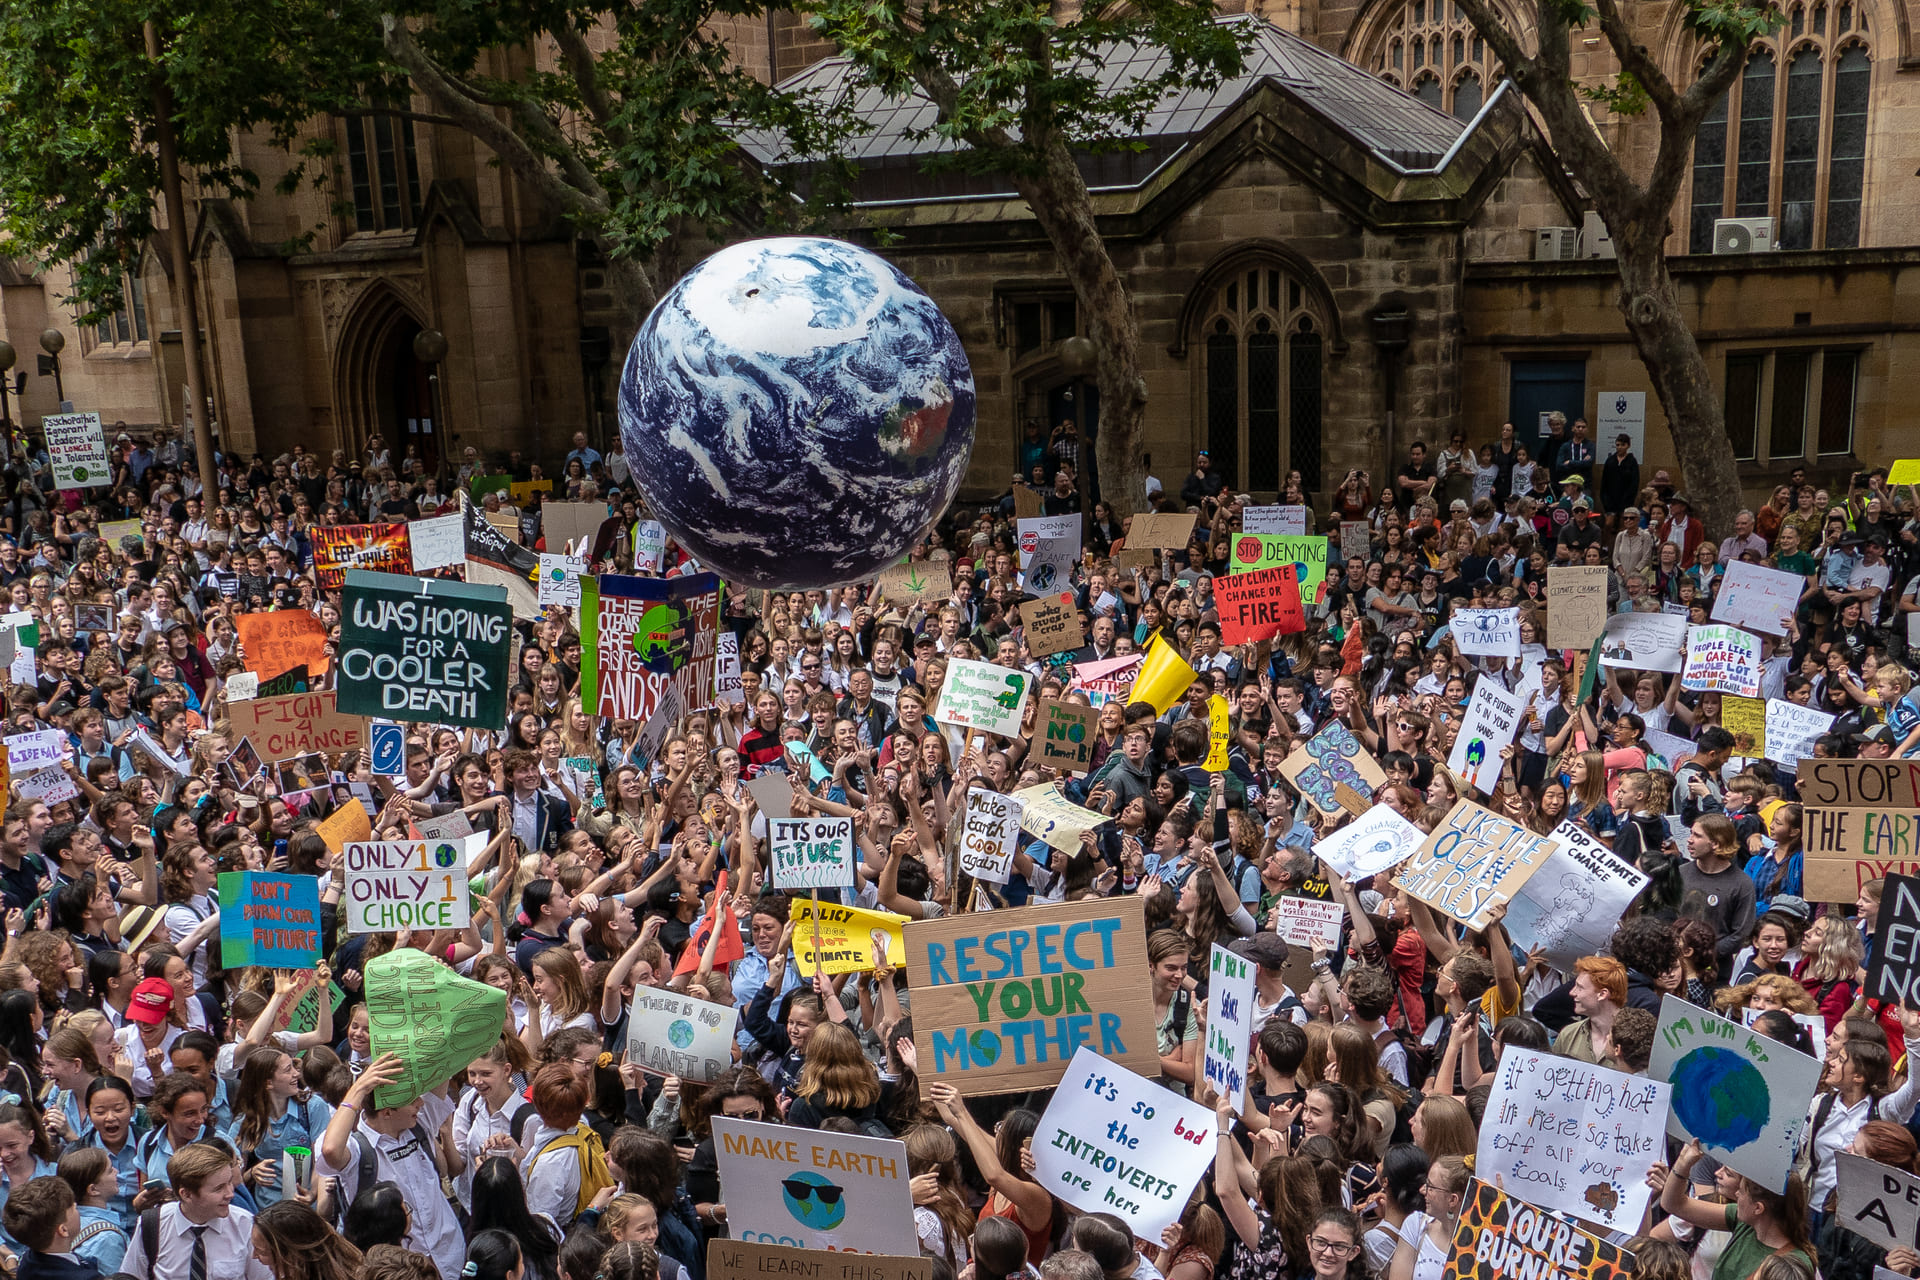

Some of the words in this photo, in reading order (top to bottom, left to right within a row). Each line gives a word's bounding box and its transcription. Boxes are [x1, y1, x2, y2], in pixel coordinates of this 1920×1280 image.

[46, 424, 88, 437] Ignorant
[48, 435, 84, 446] Leaders
[64, 444, 93, 452] LONGER
[65, 449, 105, 462] Tolerated
[1040, 521, 1073, 530] DENYING
[357, 550, 390, 563] WHILE
[1035, 552, 1072, 562] PLANET
[1038, 540, 1054, 551] NO
[1238, 543, 1262, 554] STOP
[1266, 542, 1326, 562] DENYING
[541, 558, 552, 567] IS
[566, 556, 581, 566] B
[414, 578, 435, 600] I
[541, 575, 551, 601] THERE
[565, 568, 580, 606] PLANET
[1218, 574, 1244, 590] STOP
[1247, 567, 1290, 585] CLIMATE
[686, 592, 717, 611] THE
[1226, 588, 1266, 602] CHANGE
[1269, 586, 1282, 597] OR
[600, 597, 644, 616] THE
[1239, 602, 1281, 626] FIRE
[353, 598, 418, 632] WAS
[421, 605, 507, 643] HOPING
[598, 612, 640, 633] OCEANS
[1032, 614, 1061, 632] gives
[1041, 622, 1065, 635] crap
[402, 637, 446, 658] FOR
[452, 641, 470, 660] A
[598, 632, 633, 650] ARE
[1694, 641, 1724, 652] PEOPLE
[1728, 643, 1753, 658] LIKE
[1697, 626, 1752, 650] UNLESS
[342, 648, 491, 690] COOLER
[600, 650, 644, 671] RISING
[718, 657, 736, 674] IF
[1690, 662, 1723, 671] WHOLE
[1727, 662, 1751, 676] LOT
[1706, 651, 1734, 662] CARE
[1737, 656, 1746, 665] A
[955, 665, 975, 677] I'm
[1729, 674, 1756, 686] WILL
[259, 673, 294, 697] ZERO
[599, 672, 645, 720] AND
[253, 693, 336, 724] FIGHT
[383, 683, 477, 718] DEATH
[1480, 687, 1492, 704] OUR
[1492, 697, 1516, 718] FUTURE
[1050, 705, 1077, 723] There
[1475, 703, 1481, 713] IS
[1482, 708, 1491, 720] IN
[1493, 714, 1510, 733] YOUR
[17, 733, 42, 743] VOTE
[296, 720, 312, 734] 4
[1476, 722, 1495, 740] HANDS
[268, 728, 358, 754] CHANGE
[1044, 742, 1075, 760] Planet
[9, 745, 61, 763] LIBERAL
[1814, 763, 1900, 804] STOP
[969, 794, 1006, 817] Make
[426, 829, 440, 839] KEEP
[776, 822, 809, 841] IT'S
[814, 820, 849, 839] OUR
[967, 816, 1007, 839] Earth
[1449, 804, 1509, 844] LIKE
[1499, 825, 1550, 865] THE
[1804, 809, 1849, 852] THE
[349, 844, 414, 871] ONLY
[414, 843, 432, 871] 1
[966, 834, 1006, 857] COOL
[1556, 822, 1591, 848] STOP
[1590, 848, 1642, 888] CLIMATE
[963, 853, 1010, 875] again!
[1411, 851, 1445, 880] WE
[1433, 831, 1517, 887] OCEAN
[1567, 848, 1612, 883] CHANGE
[252, 881, 292, 900] DON'T
[352, 876, 429, 901] ONLY
[440, 875, 457, 901] 1
[1429, 870, 1508, 929] RISE
[243, 904, 281, 921] BURN
[284, 908, 314, 924] OUR
[364, 901, 452, 928] CHOICE
[801, 908, 855, 923] POLICY
[1288, 908, 1308, 916] GREEN
[1311, 910, 1327, 919] AGAIN
[1295, 919, 1316, 928] GREED
[253, 929, 318, 951] FUTURE
[927, 918, 1121, 985] RESPECT
[1212, 951, 1223, 972] WHY
[407, 955, 438, 998] THAN
[368, 955, 407, 1029] CHANGE
[966, 972, 1092, 1022] YOUR
[640, 996, 679, 1013] THERE
[682, 1003, 693, 1016] IS
[698, 1008, 721, 1027] NO
[411, 1001, 447, 1069] WORSE
[932, 1013, 1127, 1073] MOTHER
[630, 1039, 698, 1078] PLANET
[705, 1059, 721, 1081] B
[1537, 1066, 1614, 1115] getting
[1619, 1081, 1656, 1114] hot
[1085, 1073, 1118, 1102] it's
[1131, 1101, 1155, 1120] so
[1174, 1117, 1207, 1145] bad
[1107, 1120, 1139, 1149] the
[1530, 1106, 1580, 1139] here,
[1614, 1126, 1652, 1153] take
[722, 1133, 800, 1163] MAKE
[812, 1146, 897, 1179] EARTH
[1051, 1128, 1177, 1200] INTROVERTS
[1495, 1132, 1535, 1154] off
[1546, 1147, 1572, 1162] all
[1582, 1158, 1622, 1181] your
[1061, 1171, 1092, 1191] are
[1104, 1186, 1140, 1215] here
[1504, 1198, 1587, 1270] YOU'RE
[722, 1251, 744, 1268] WE
[759, 1257, 823, 1278] LEARNT
[842, 1265, 884, 1280] THIS
